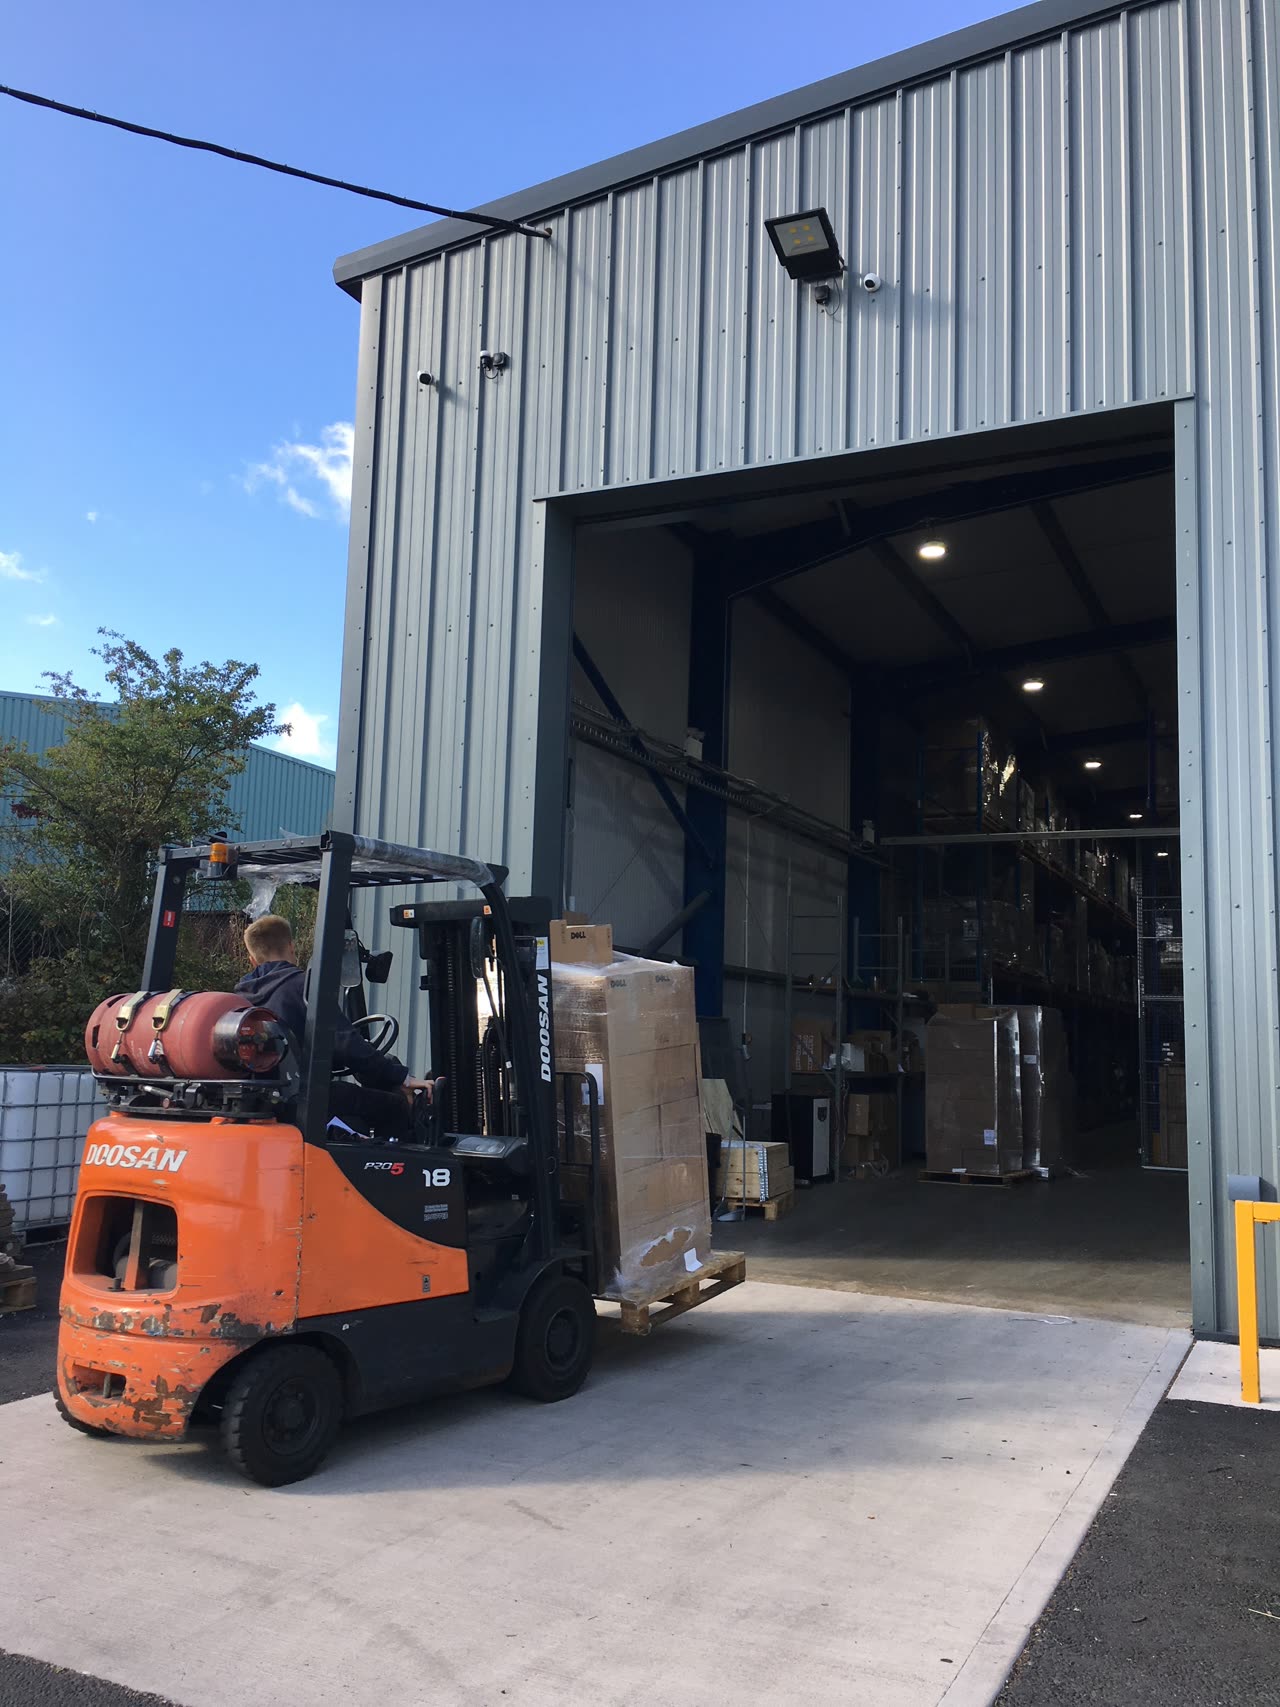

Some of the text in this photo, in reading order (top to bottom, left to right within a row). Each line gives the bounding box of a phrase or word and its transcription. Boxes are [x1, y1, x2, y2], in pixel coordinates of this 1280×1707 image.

[570, 931, 586, 939] DELL
[536, 974, 552, 1082] DOOSAN
[85, 1143, 188, 1172] DOOSAN
[422, 1168, 450, 1187] 18
